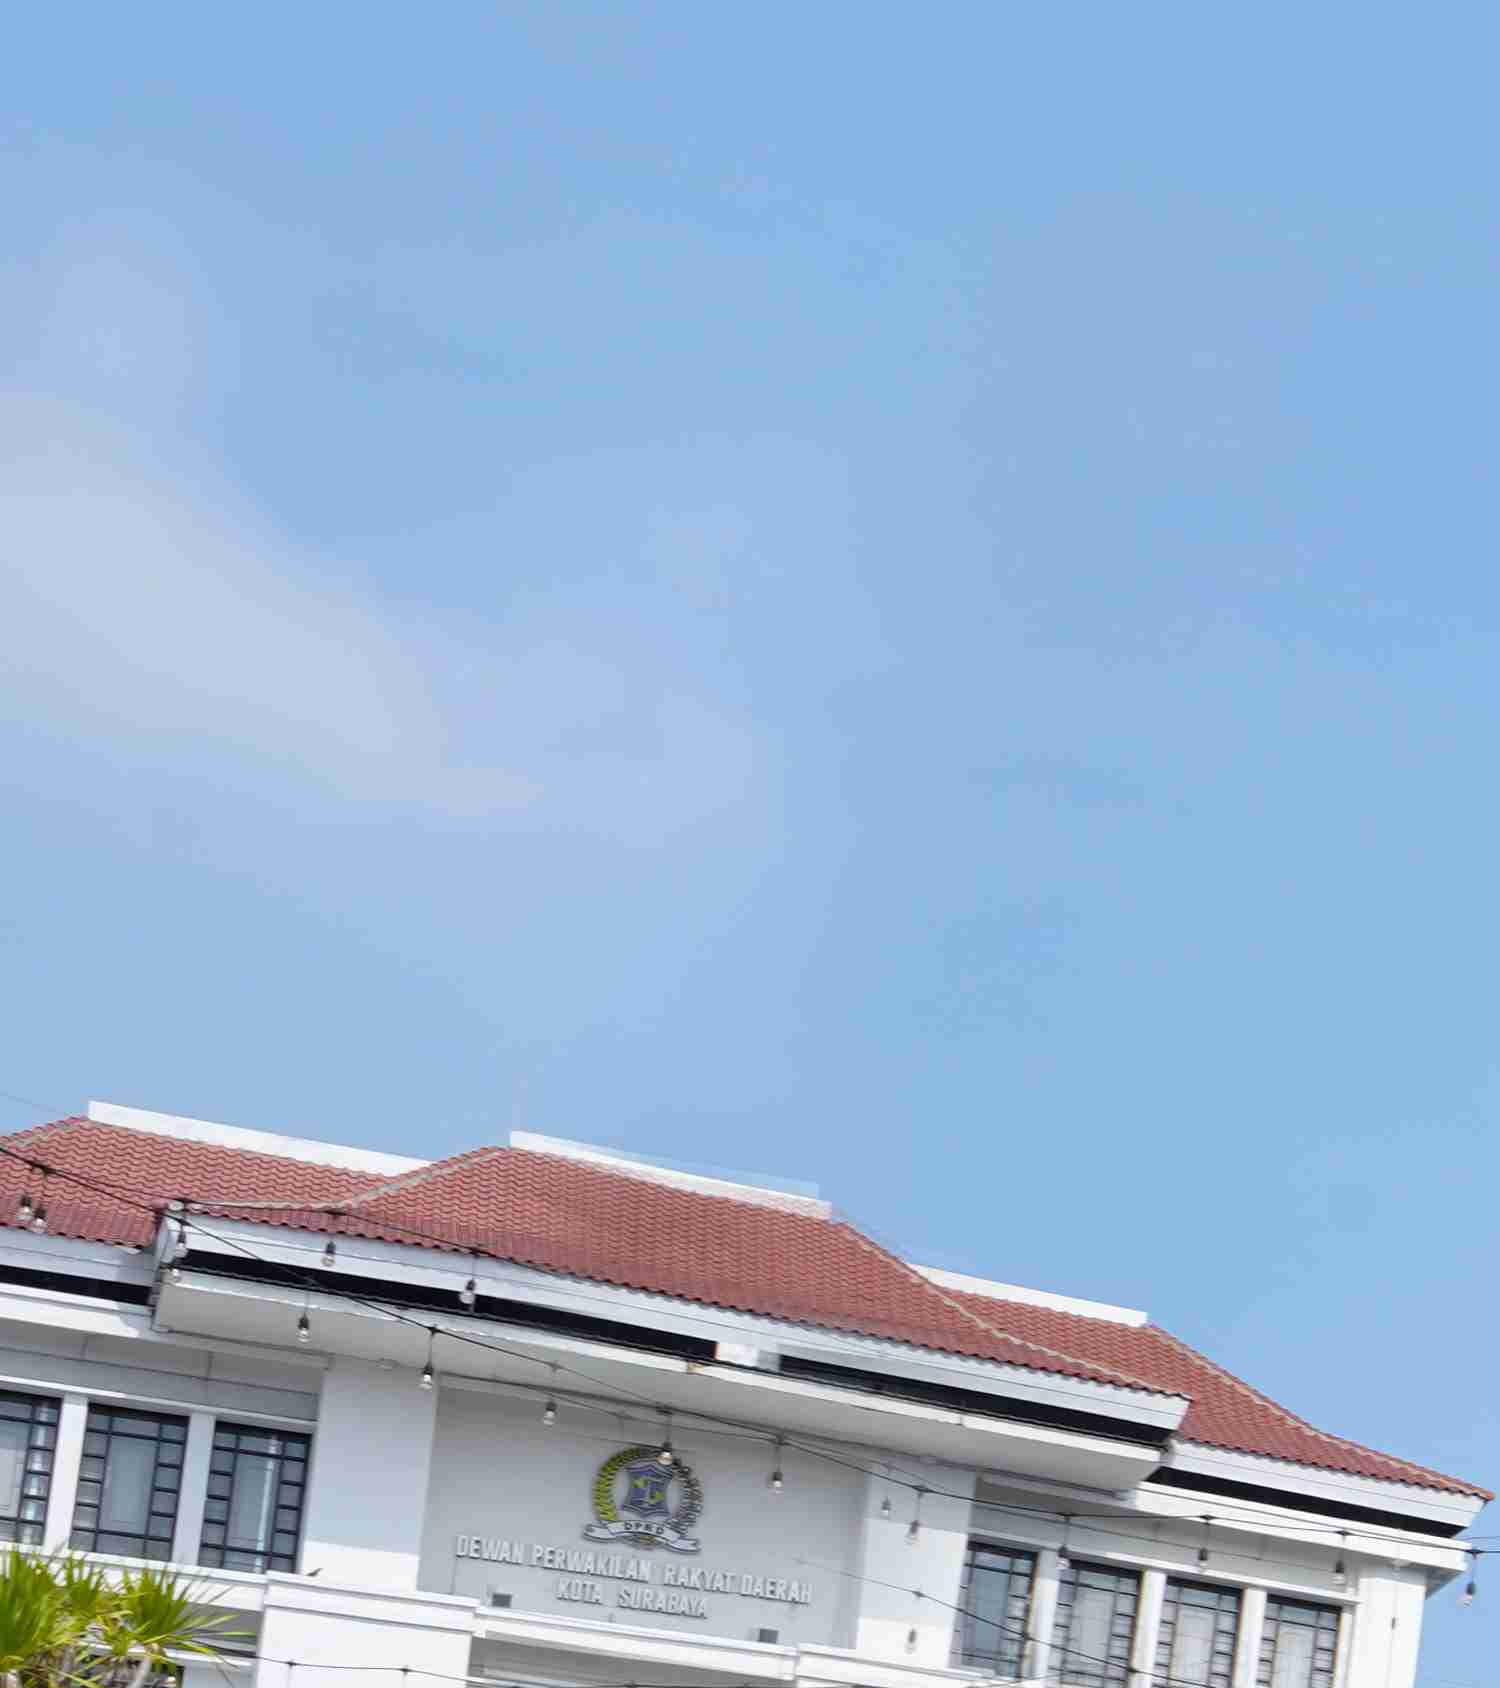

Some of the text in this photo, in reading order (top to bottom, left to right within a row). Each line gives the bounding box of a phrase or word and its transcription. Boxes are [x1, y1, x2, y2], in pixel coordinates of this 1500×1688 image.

[624, 1521, 664, 1535] DPRD
[455, 1535, 812, 1604] DEWAN PERWAKILAN RAKYAT DAERAH
[556, 1577, 707, 1619] KOTA SURABAYA
